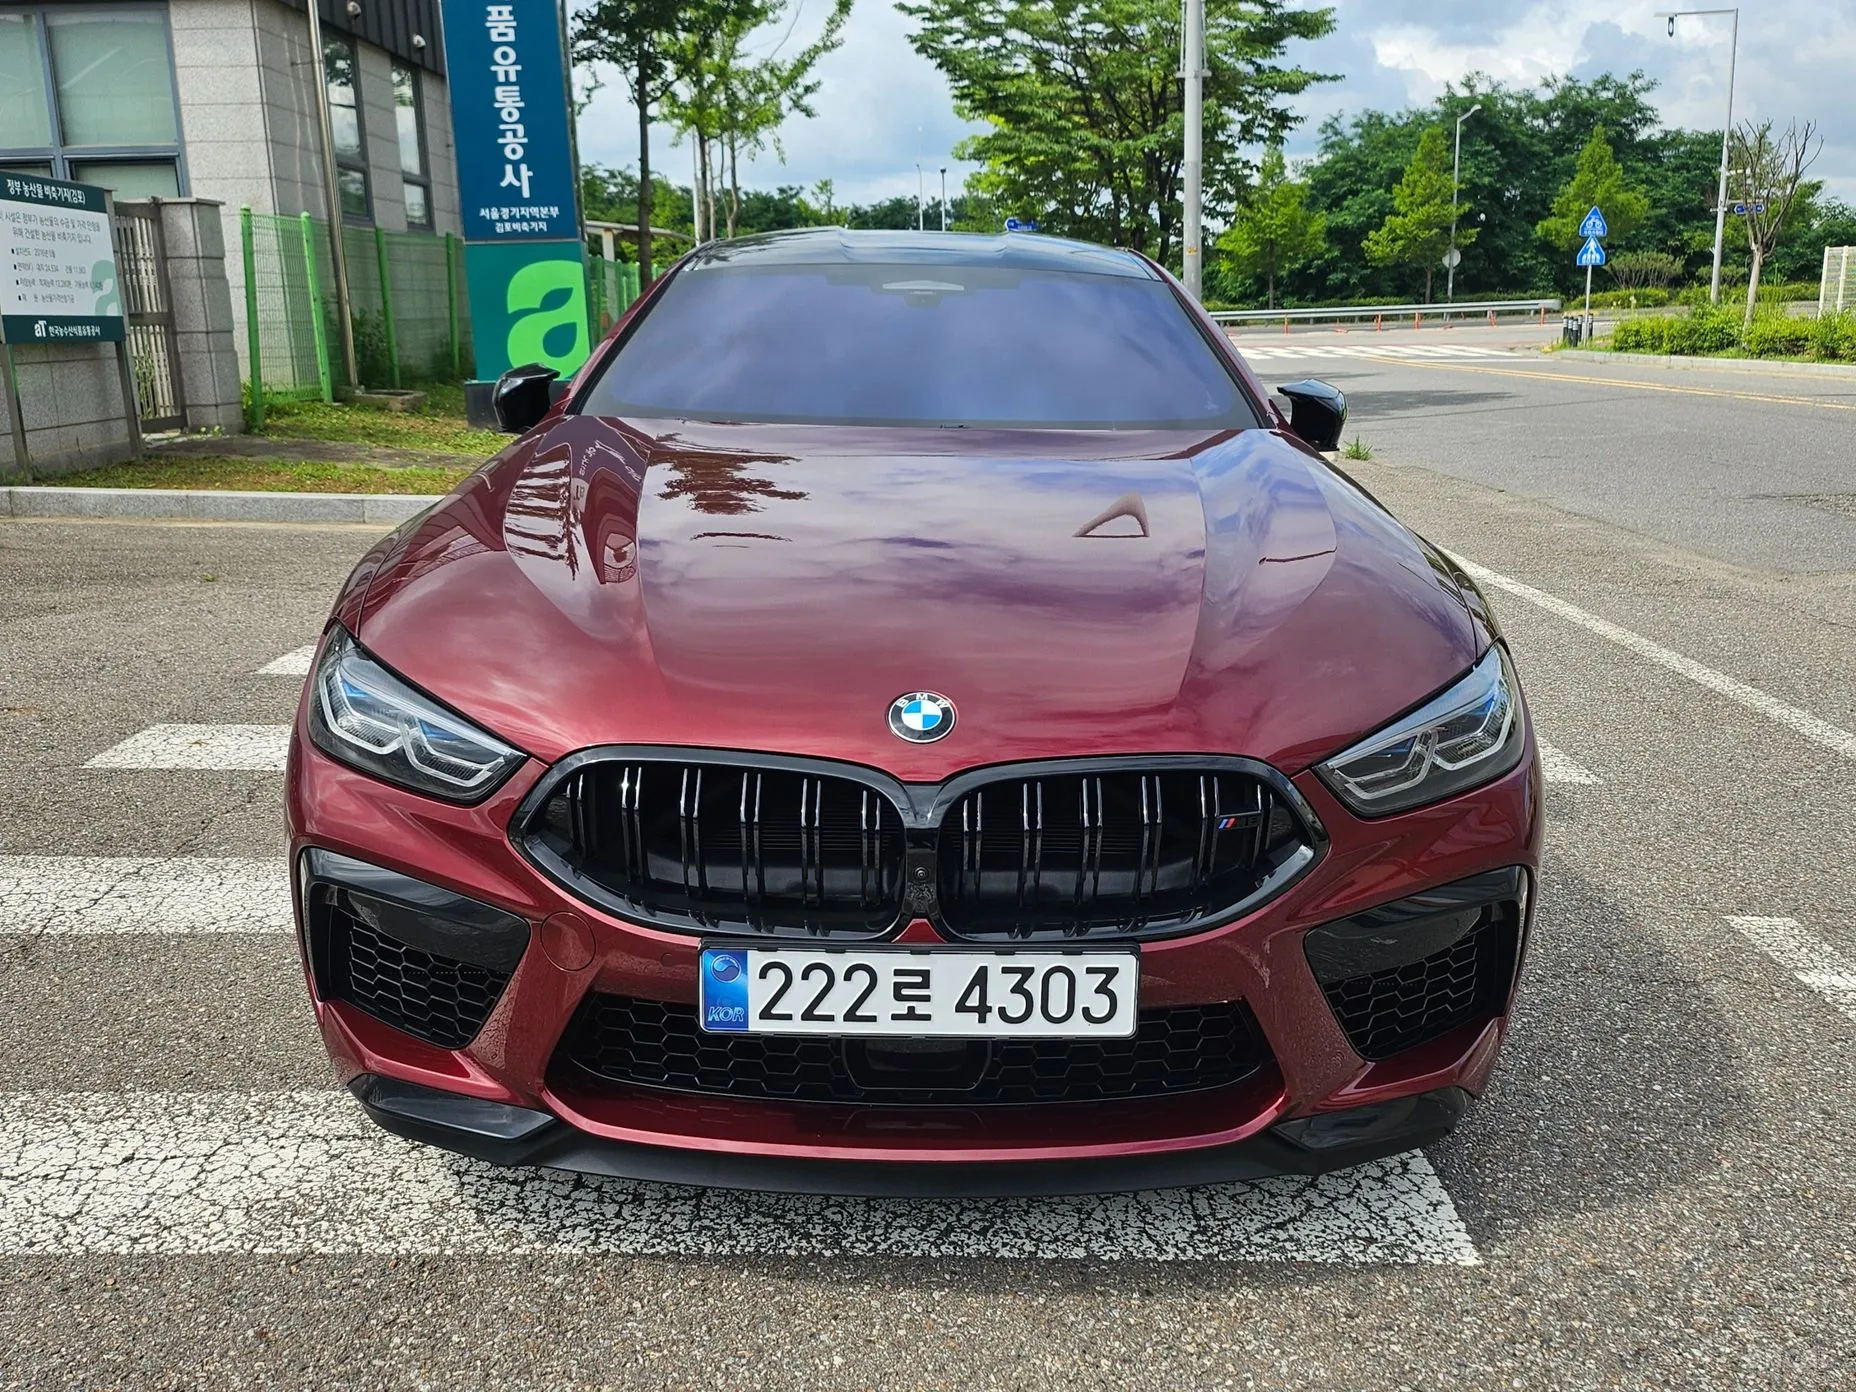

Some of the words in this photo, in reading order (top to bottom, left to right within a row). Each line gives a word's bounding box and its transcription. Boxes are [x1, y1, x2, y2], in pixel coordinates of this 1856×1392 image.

[6, 178, 22, 195] 정부
[22, 181, 44, 199] 농산물
[479, 206, 560, 220] 서울경기지역본부
[495, 221, 547, 233] 김포비축기지
[895, 693, 951, 708] BMW
[758, 961, 932, 1023] 222로
[954, 964, 1120, 1025] 4303
[707, 1006, 745, 1022] KOR
